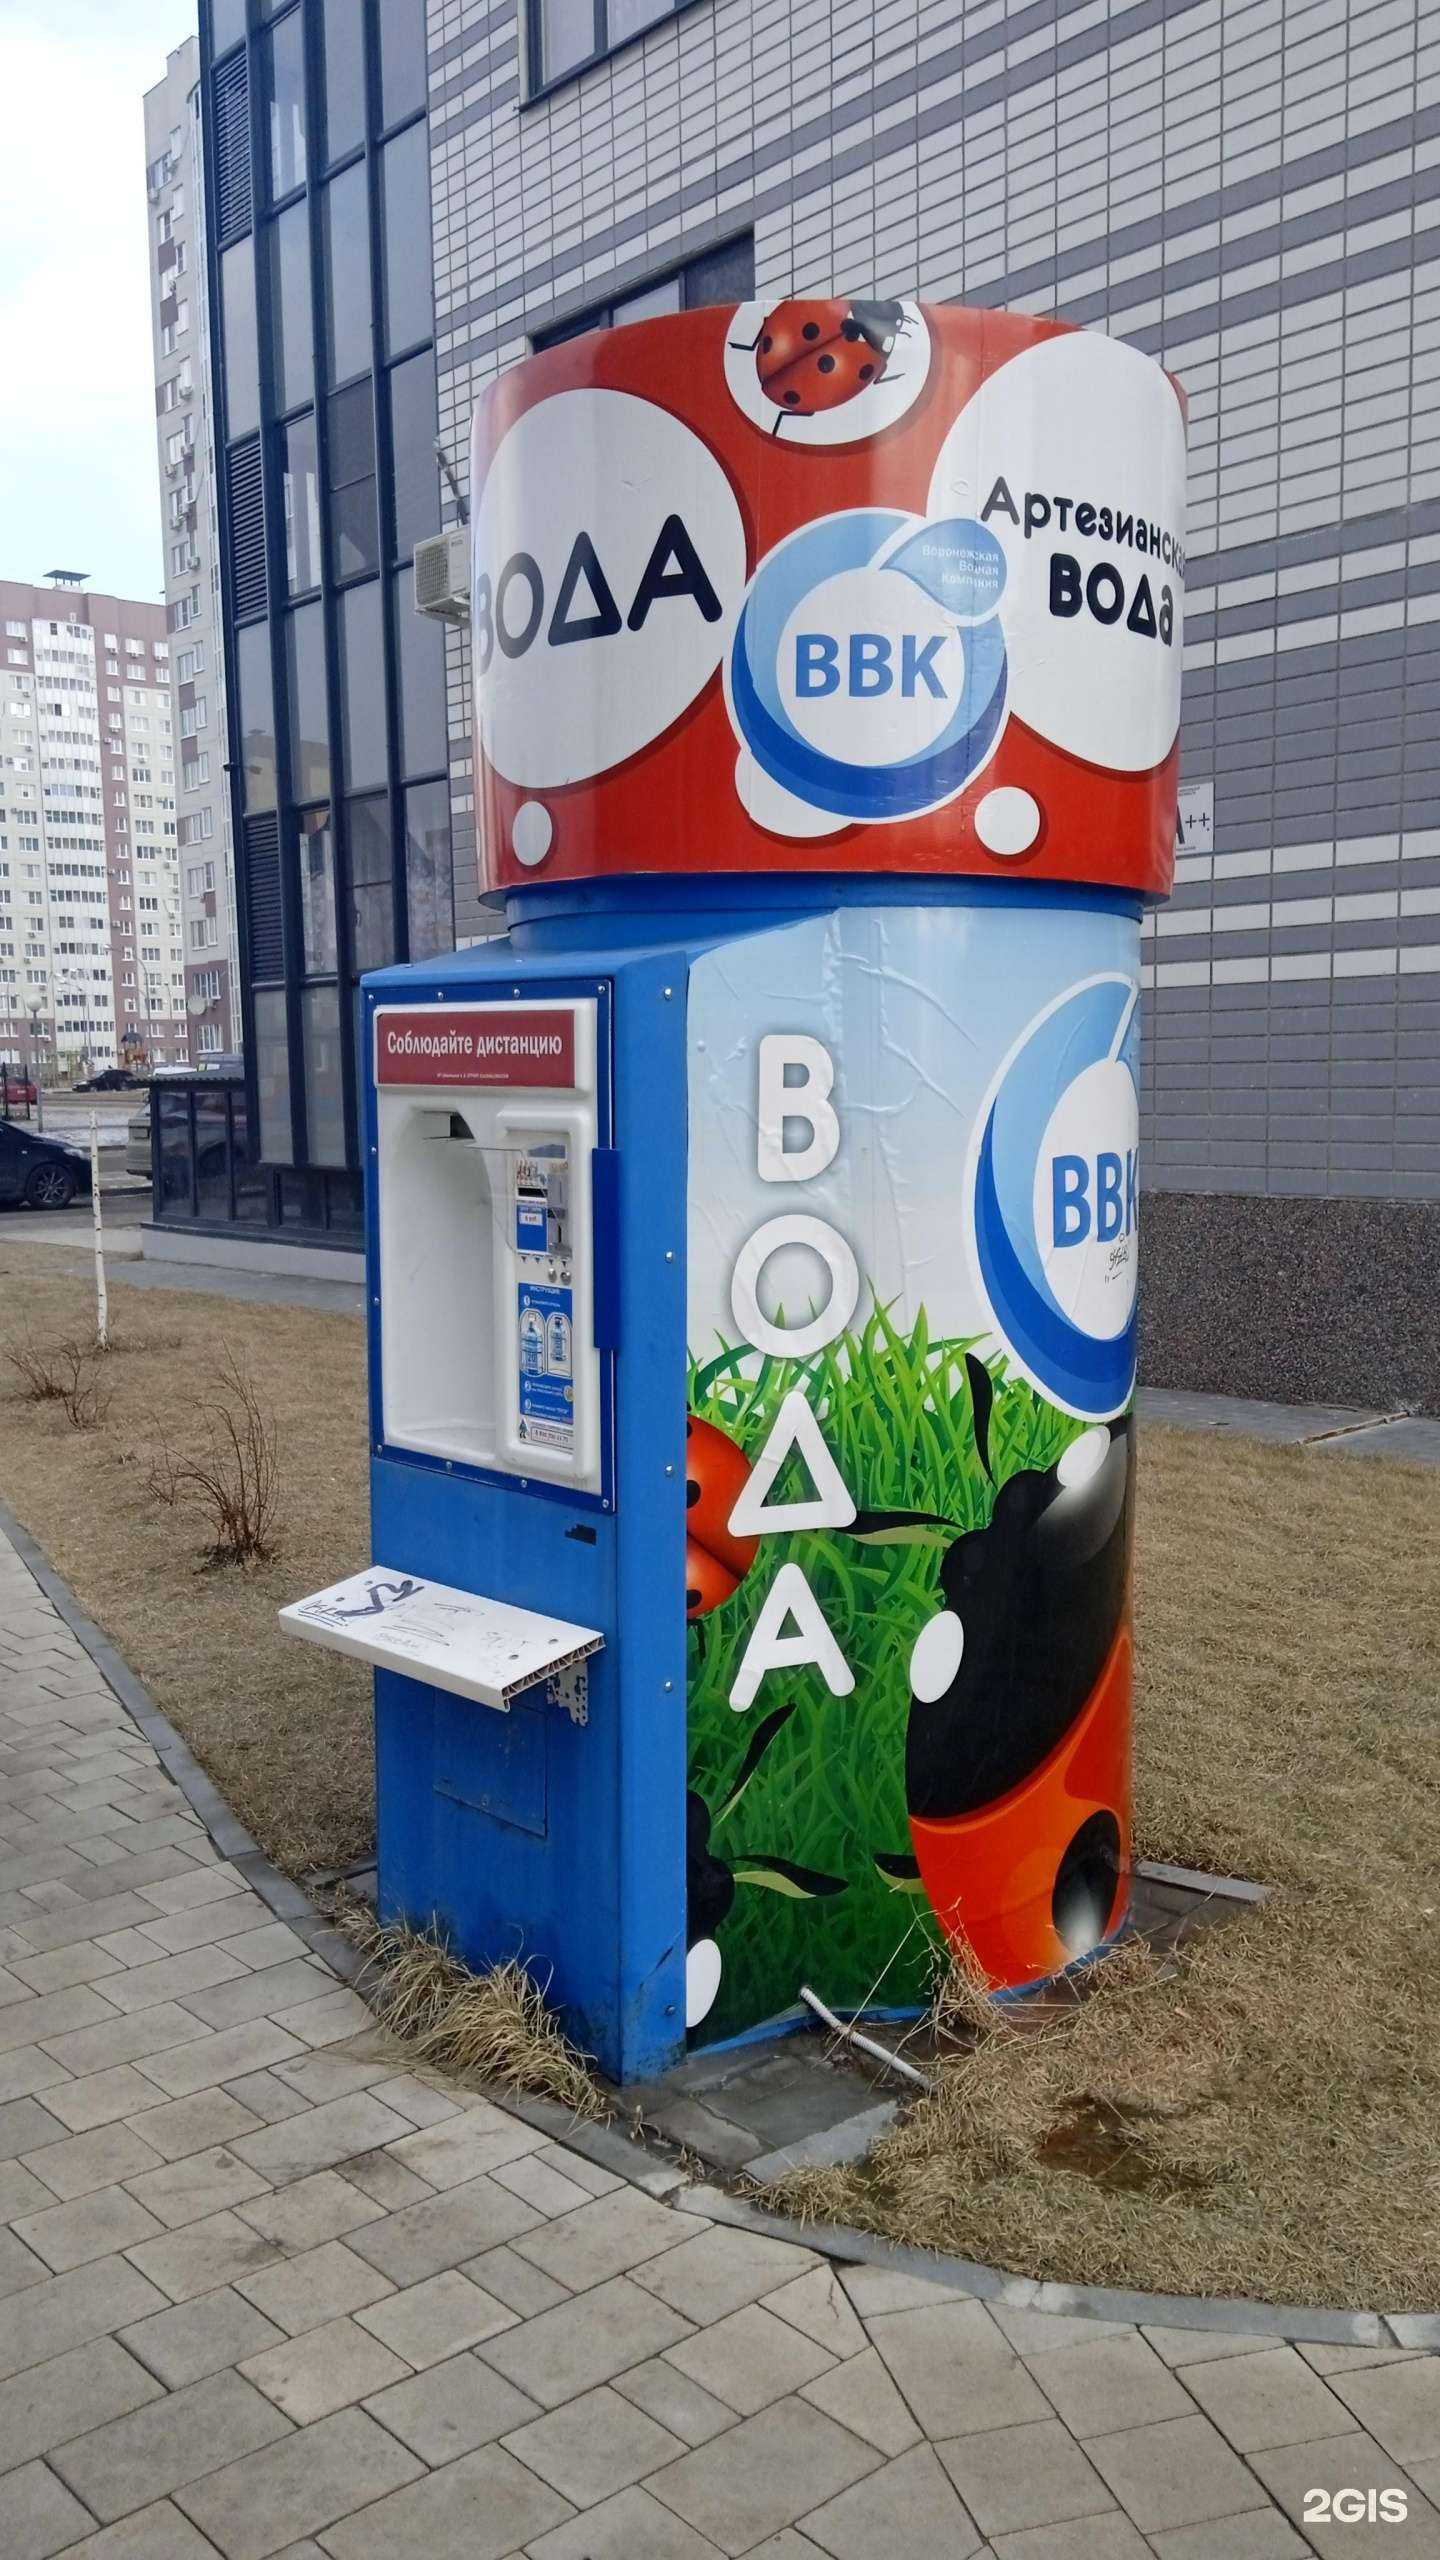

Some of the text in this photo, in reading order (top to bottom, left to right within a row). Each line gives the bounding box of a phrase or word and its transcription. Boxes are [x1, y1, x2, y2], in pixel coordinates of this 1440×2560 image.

[476, 513, 723, 676] ВОДА
[795, 633, 949, 699] ВВК
[387, 1030, 563, 1059] Соблюдайте дистанцию
[727, 1034, 859, 1713] ВОДА
